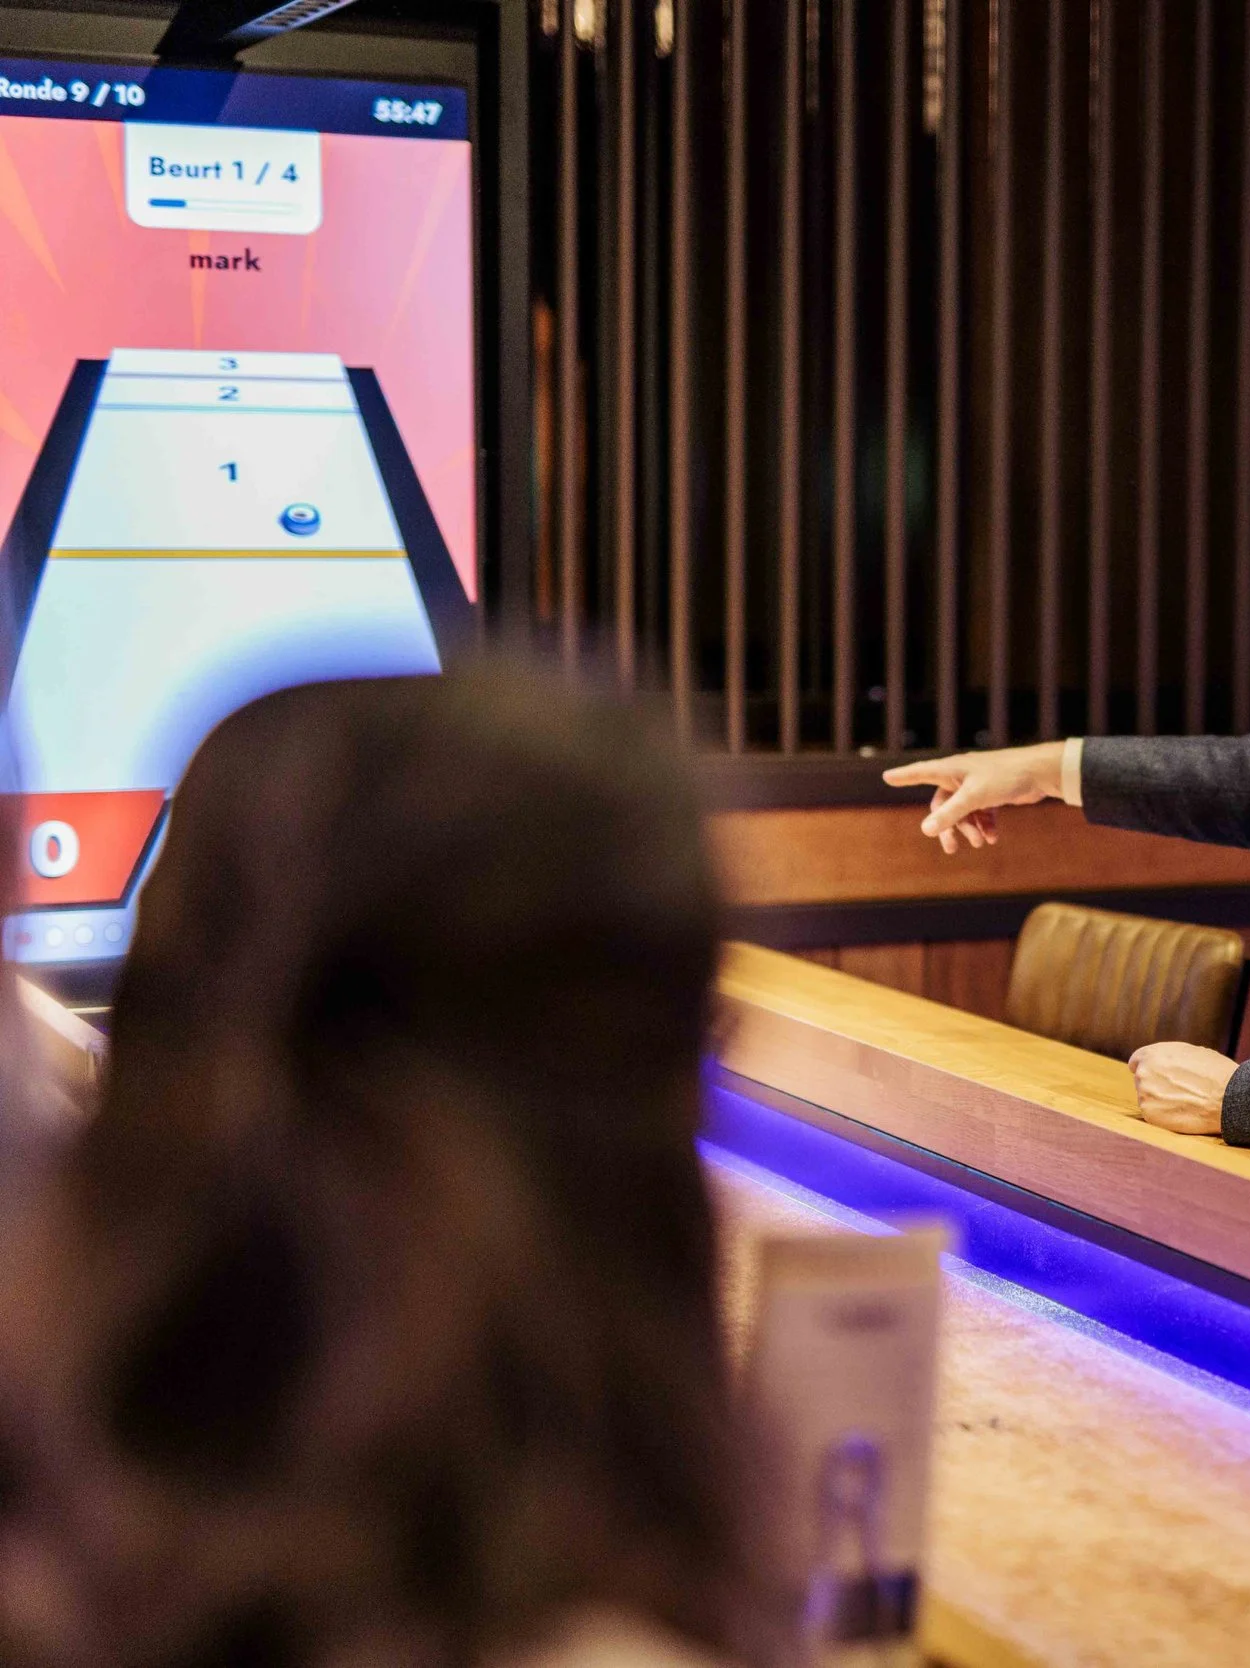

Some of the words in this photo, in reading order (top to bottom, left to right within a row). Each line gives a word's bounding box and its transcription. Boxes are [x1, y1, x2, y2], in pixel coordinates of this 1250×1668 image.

[70, 81, 90, 103] 9
[113, 83, 146, 107] 10
[149, 156, 222, 179] Beurt
[232, 160, 243, 180] 1
[281, 163, 299, 182] 4
[189, 247, 261, 271] mark
[218, 357, 238, 371] 3
[218, 385, 239, 401] 2
[218, 461, 238, 482] 1
[30, 820, 79, 878] 0
